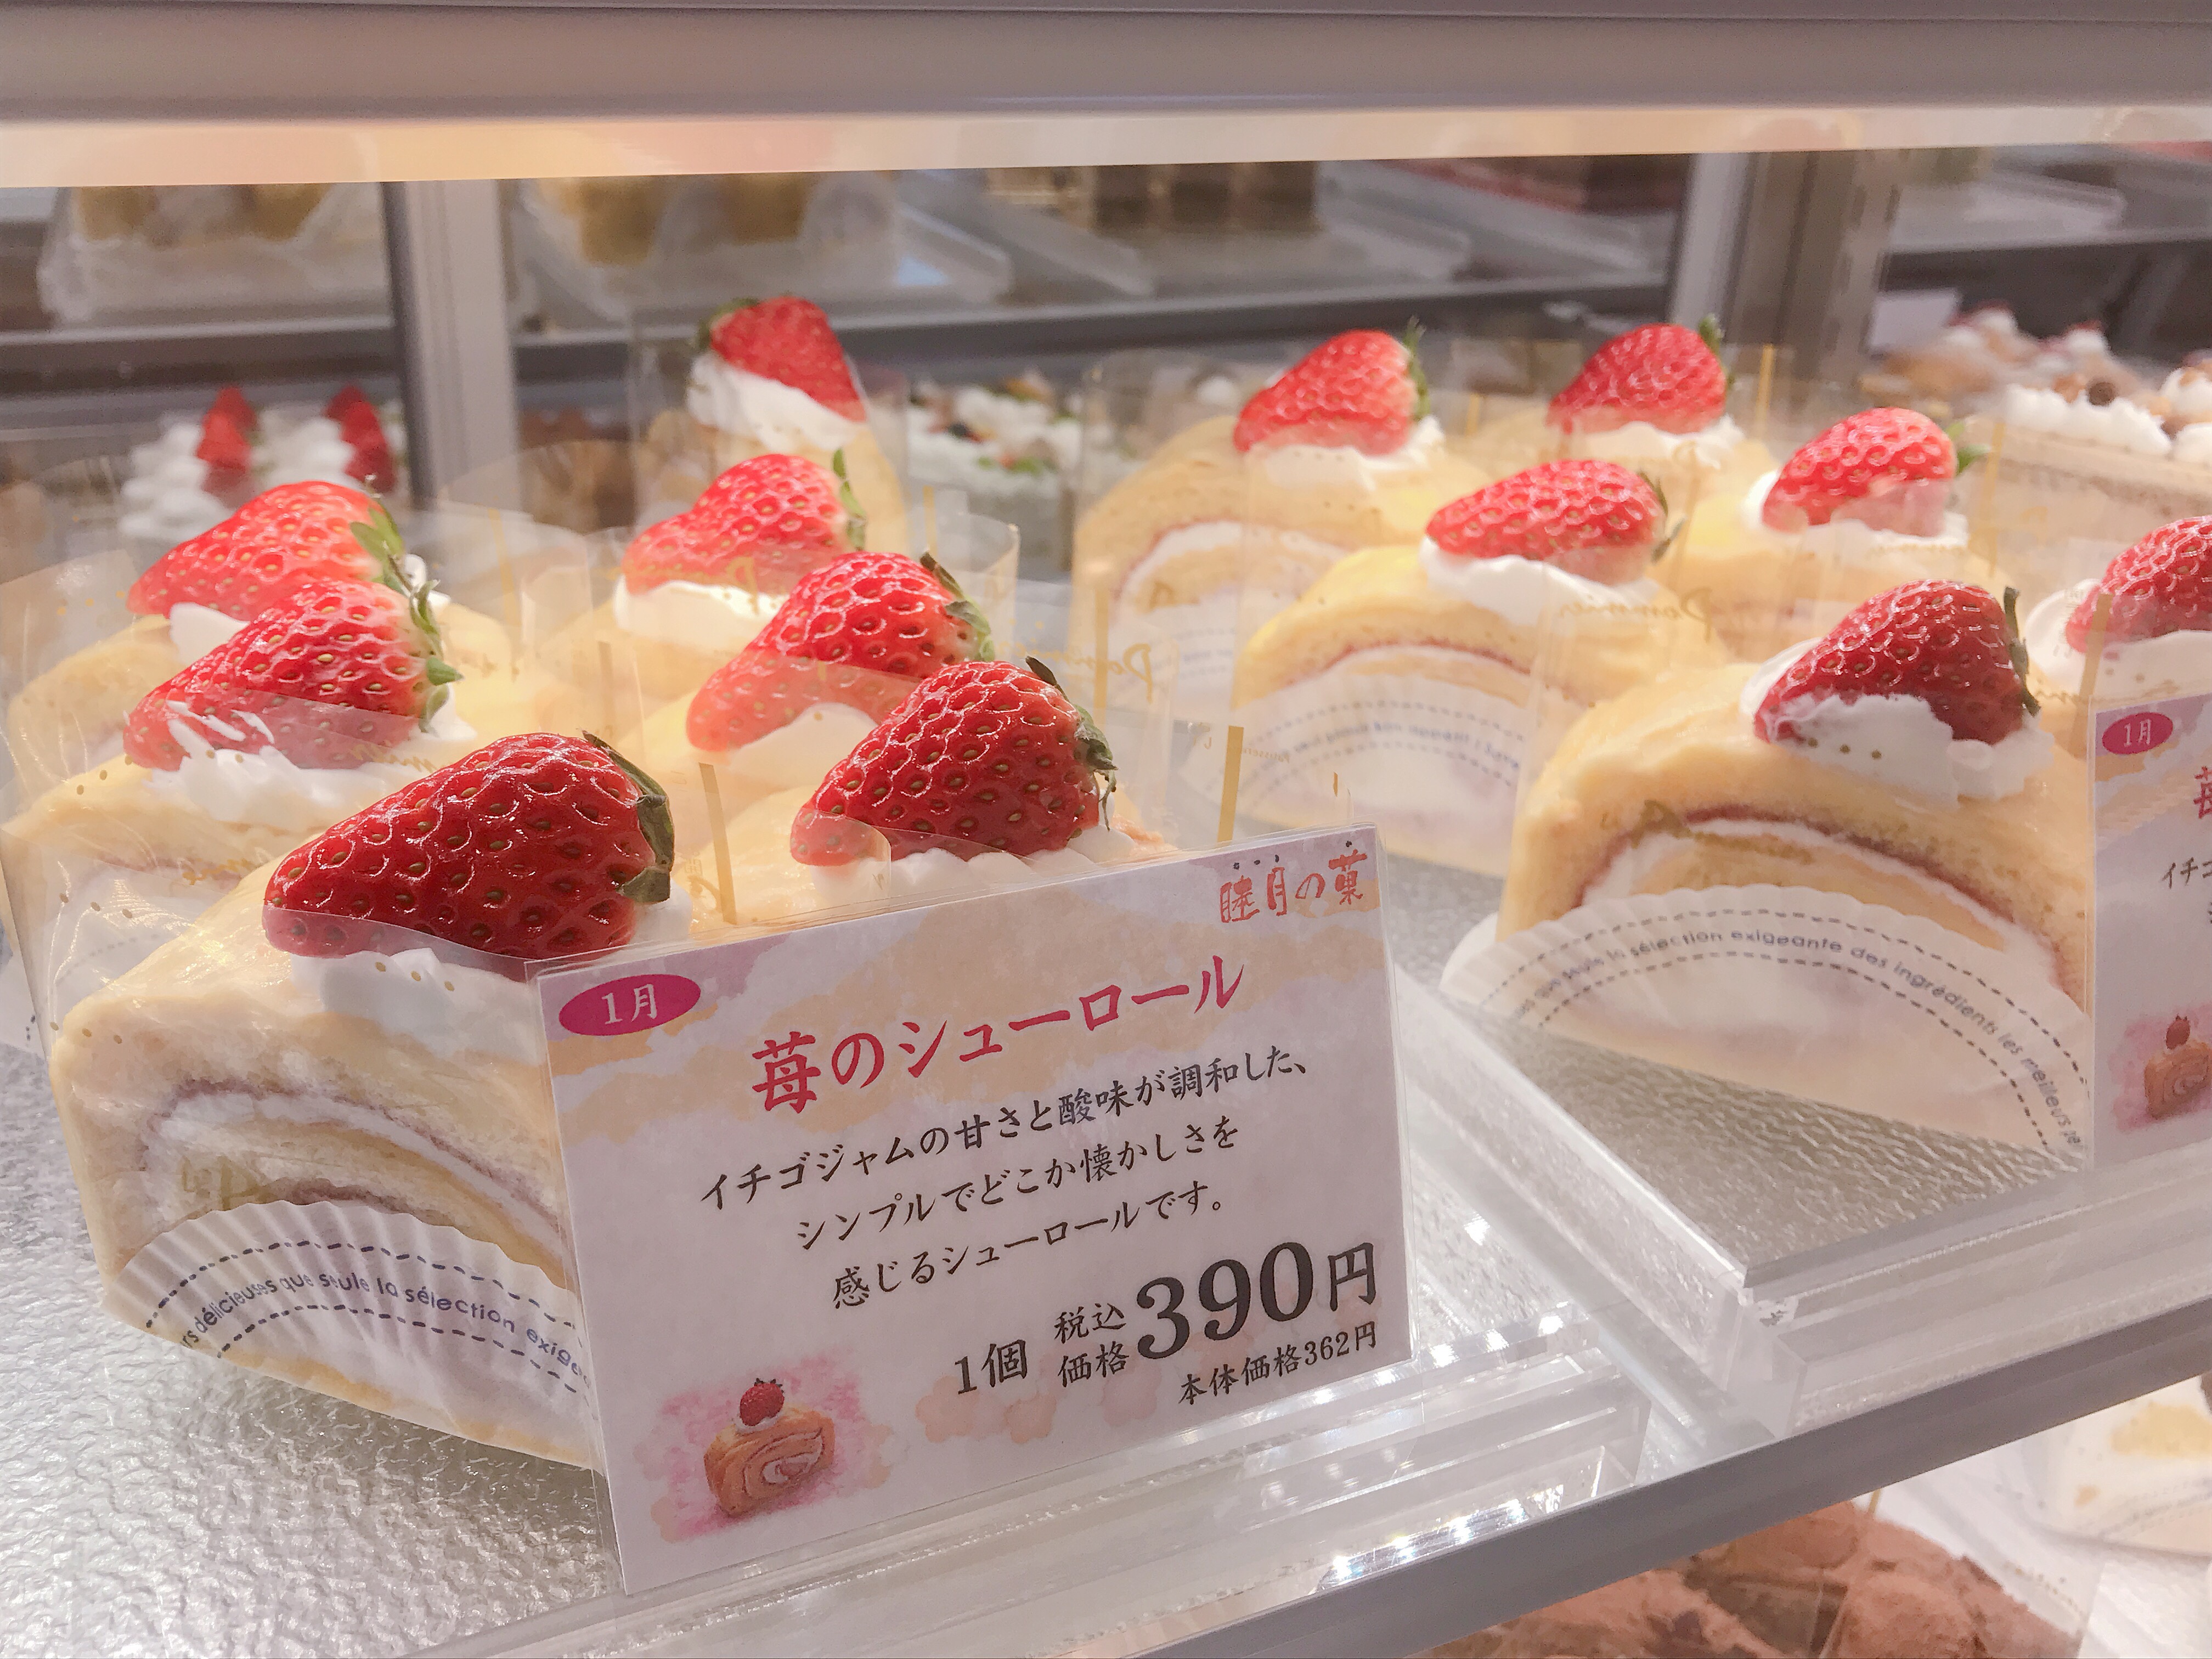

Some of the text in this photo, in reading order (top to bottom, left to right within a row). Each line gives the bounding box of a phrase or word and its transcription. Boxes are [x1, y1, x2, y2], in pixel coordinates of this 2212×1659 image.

[2124, 719, 2151, 747] 1月
[1220, 849, 1368, 923] 睦月の菓
[1730, 929, 1842, 953] exigeante
[1850, 946, 1888, 969] des
[601, 983, 658, 1025] 1月
[752, 956, 1245, 1114] 苺のシューロール
[701, 1045, 1307, 1210] イチゴジャムの甘さと酸味が調和した、
[797, 1115, 1239, 1250] シンプルでどこか懐かしさを
[832, 1180, 1222, 1309] 感じるシューロールです。
[279, 1274, 314, 1293] que
[319, 1272, 370, 1292] seule
[376, 1277, 399, 1297] la
[405, 1286, 515, 1333] sélection
[955, 1339, 1028, 1395] 1個
[1178, 1321, 1376, 1406] 本体価格362円
